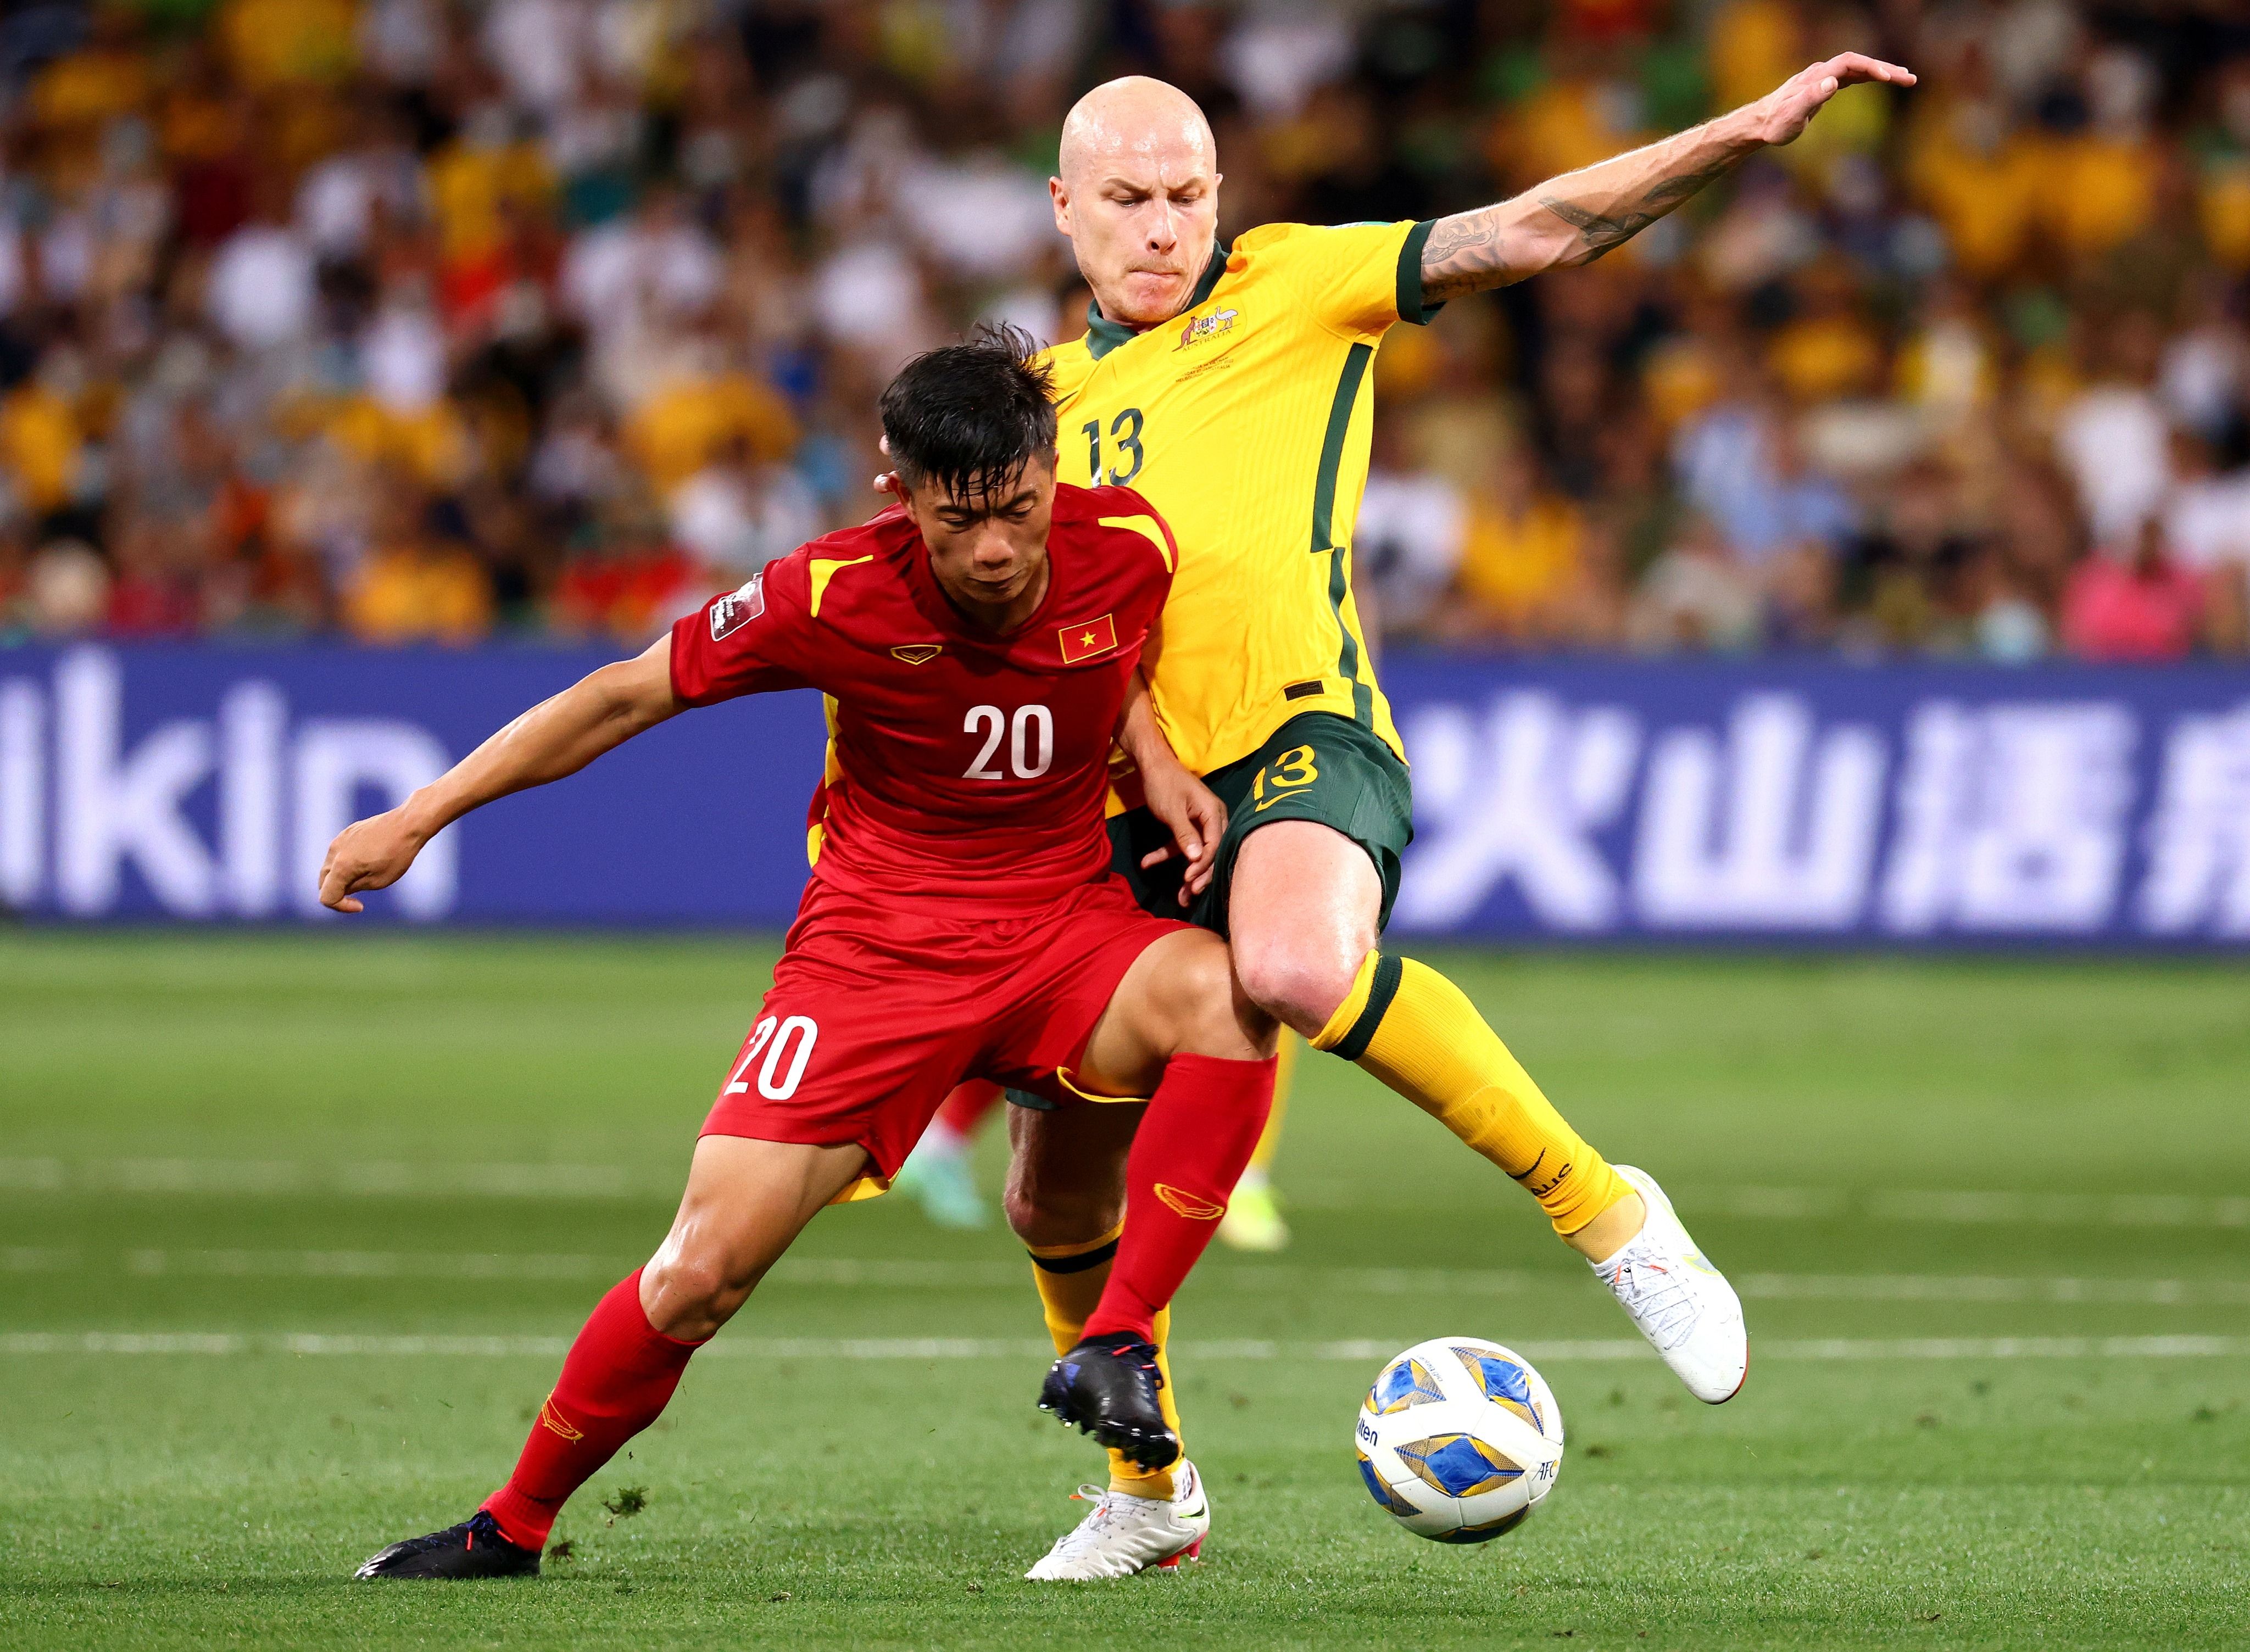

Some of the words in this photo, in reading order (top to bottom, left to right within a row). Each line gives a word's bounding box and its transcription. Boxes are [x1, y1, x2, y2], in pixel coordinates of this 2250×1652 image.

[1182, 330, 1231, 353] AUSTRALIA
[1081, 408, 1143, 488] 13
[961, 705, 1053, 779] 20
[1253, 744, 1318, 801] 13
[723, 1015, 818, 1100] 20
[1531, 1459, 1557, 1481] AFC
